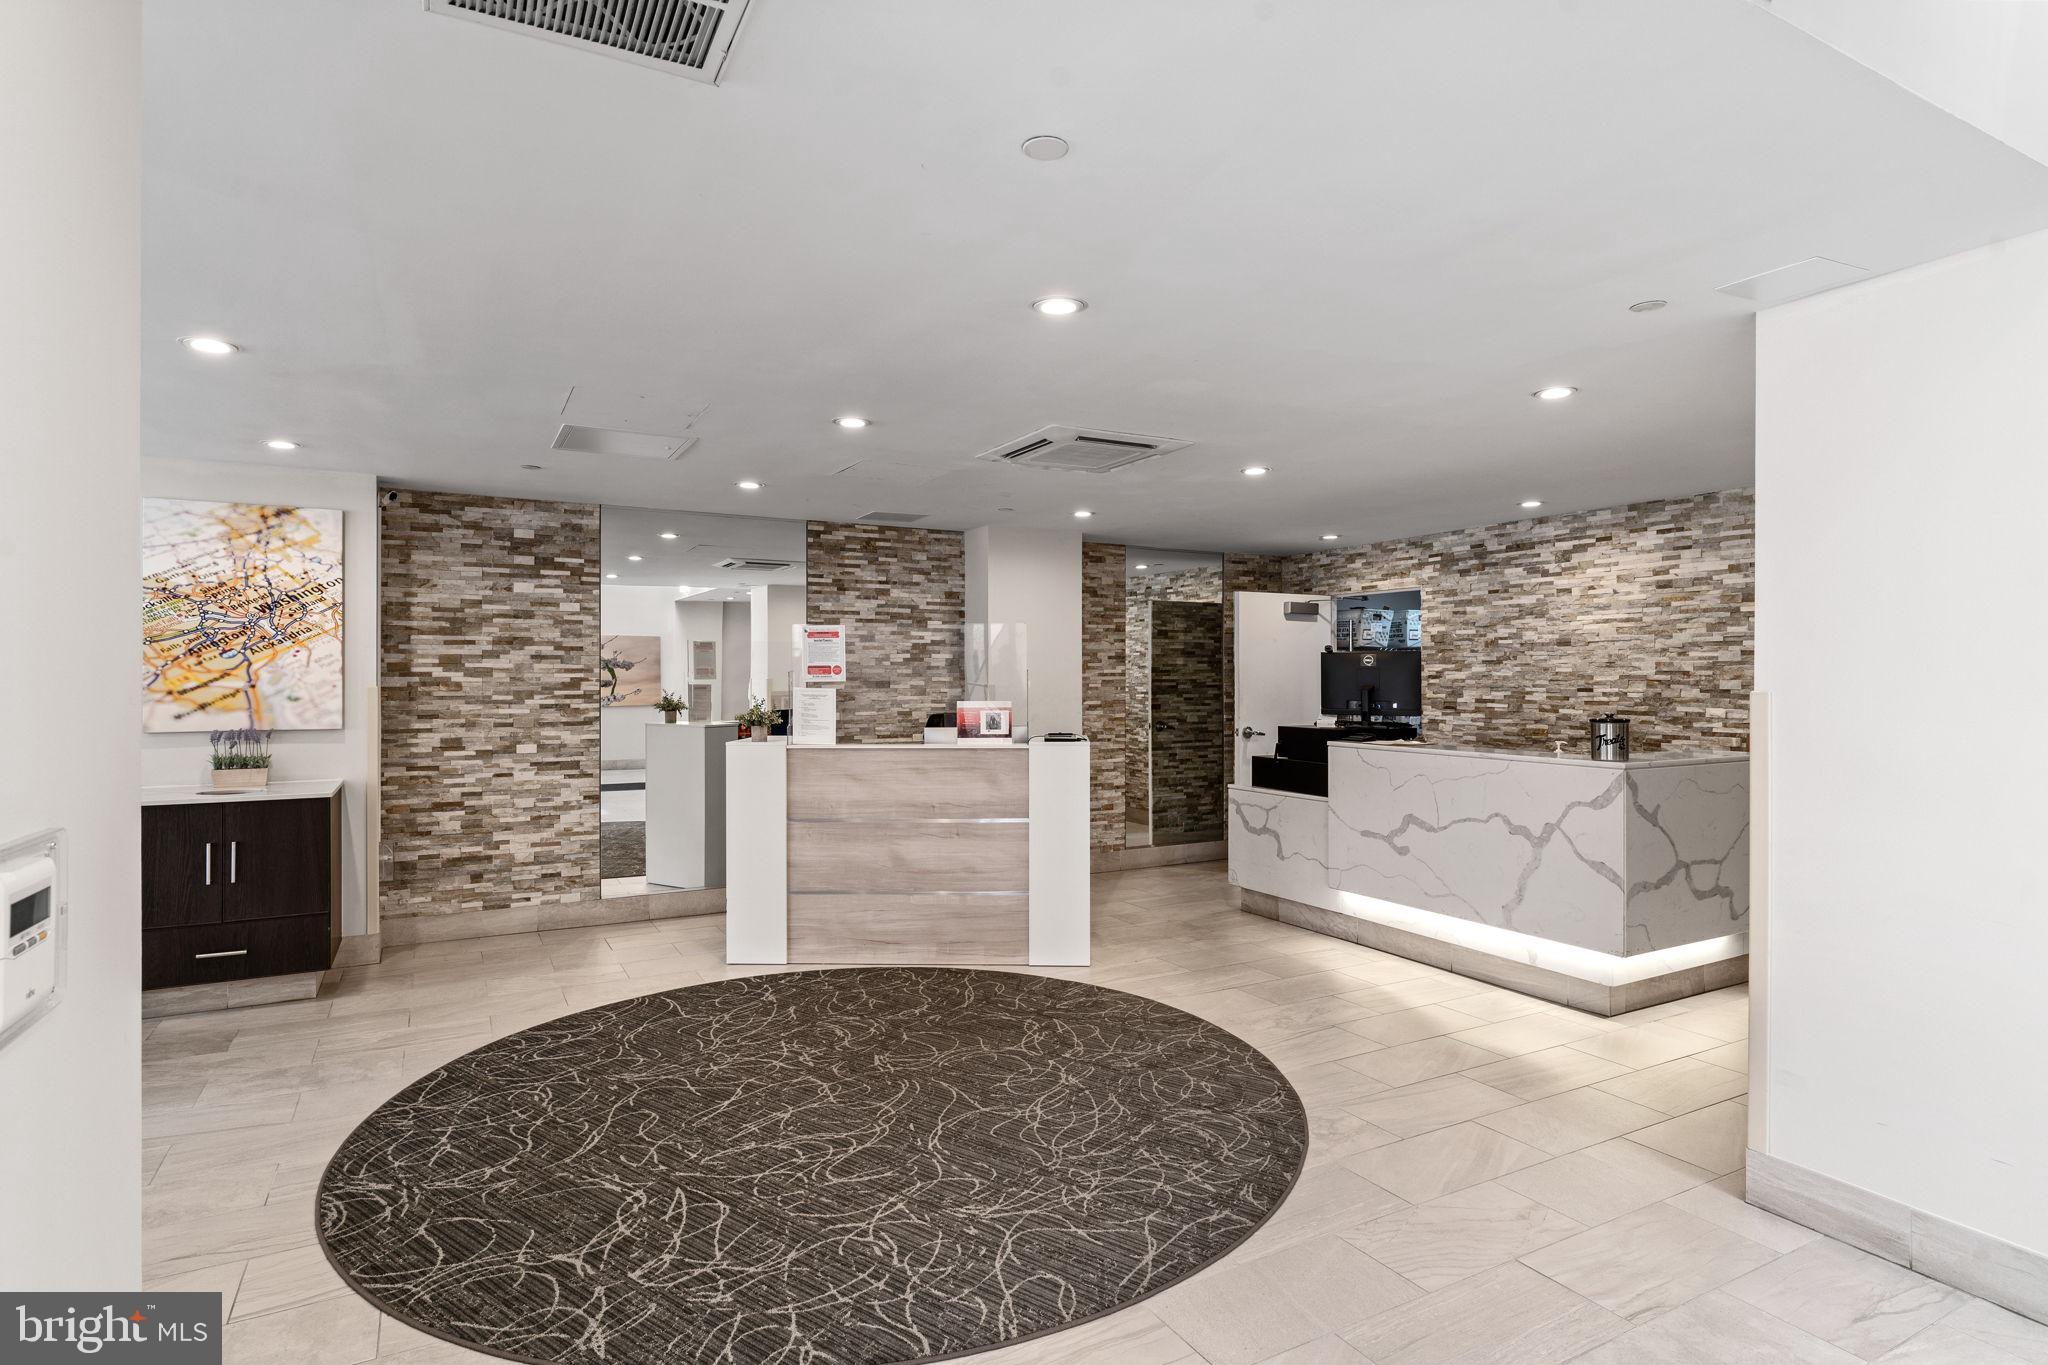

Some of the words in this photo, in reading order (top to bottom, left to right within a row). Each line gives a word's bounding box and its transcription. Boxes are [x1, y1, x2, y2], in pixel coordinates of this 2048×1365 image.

[204, 584, 239, 601] Spring
[253, 576, 343, 614] Washington
[187, 629, 249, 657] Arlington
[249, 626, 313, 656] Alexandria
